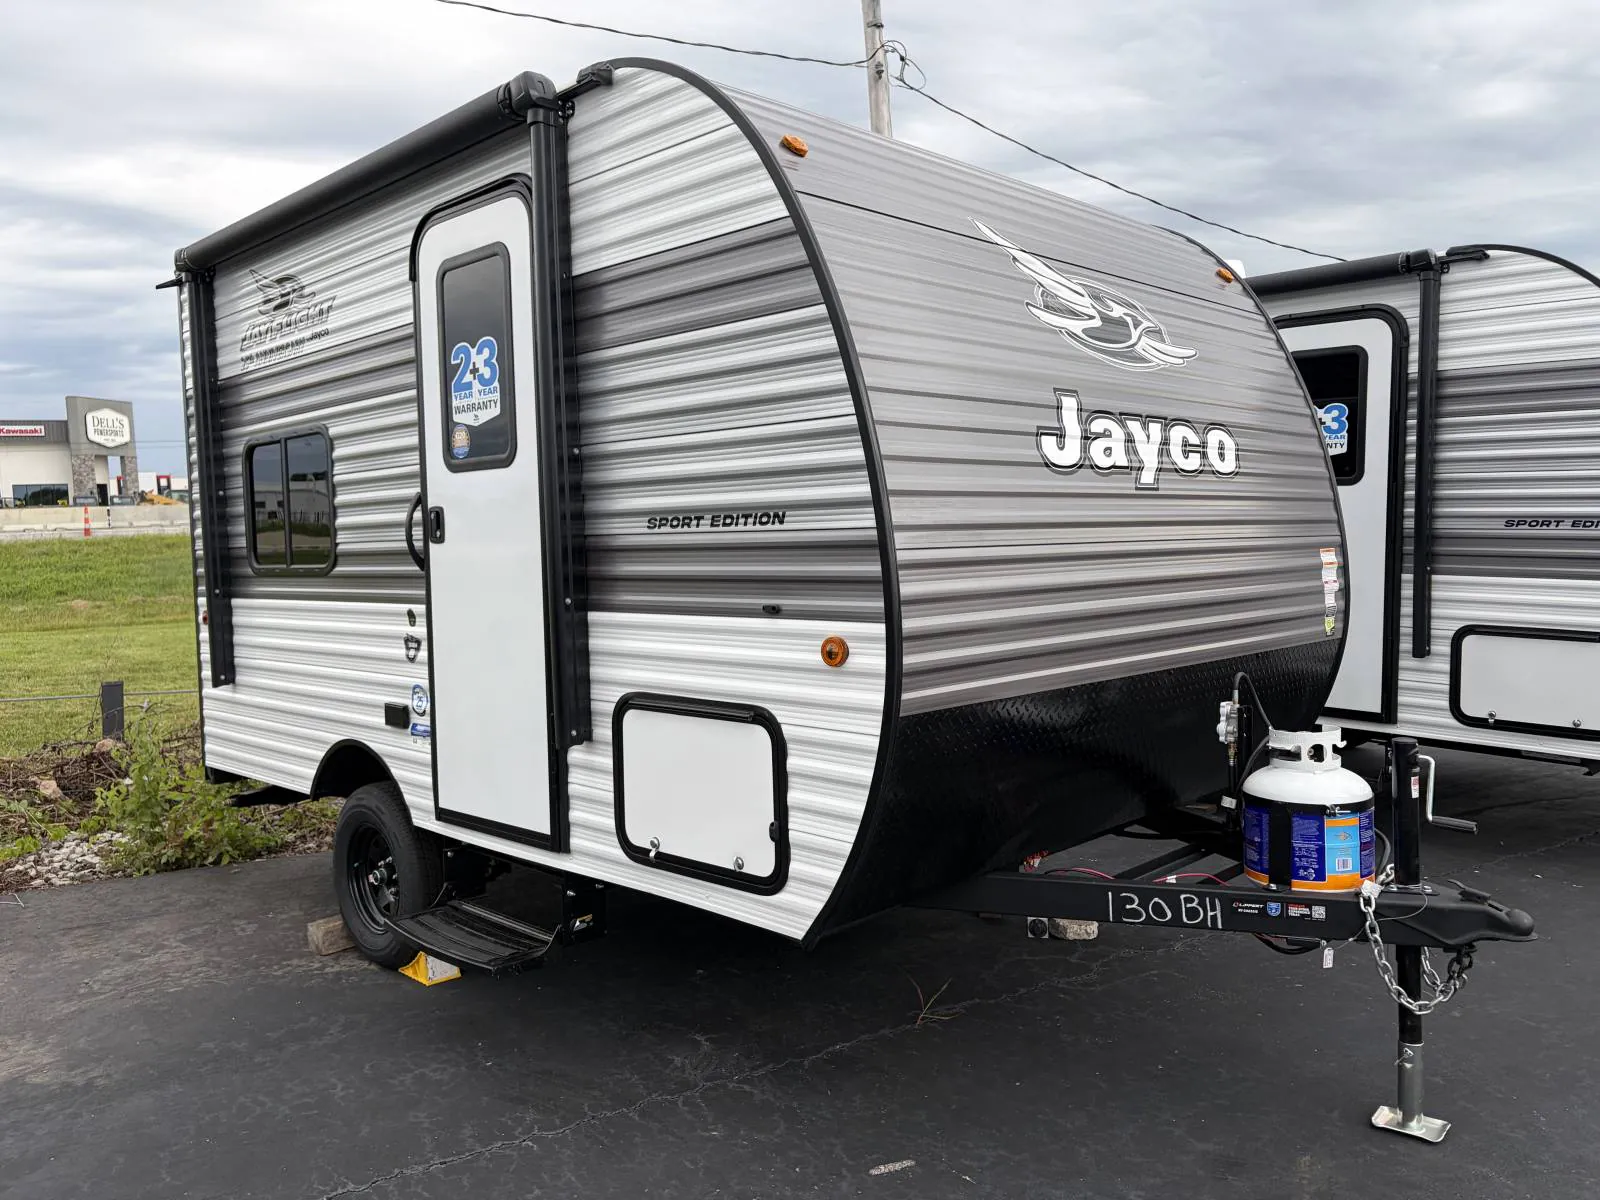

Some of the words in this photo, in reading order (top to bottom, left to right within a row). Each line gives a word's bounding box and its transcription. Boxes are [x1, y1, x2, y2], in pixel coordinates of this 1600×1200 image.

[454, 391, 473, 401] YEAR
[478, 386, 498, 397] YEAR
[454, 398, 499, 416] WARRANTY
[92, 416, 124, 429] DELL'S
[94, 428, 124, 438] POWERSPORTS
[1036, 387, 1240, 491] Jayco
[646, 515, 705, 530] SPORT
[709, 511, 787, 528] EDITION
[1503, 519, 1565, 528] SPORT
[1570, 519, 1600, 529] EDI
[1108, 891, 1172, 923] 130
[1180, 893, 1222, 929] BH
